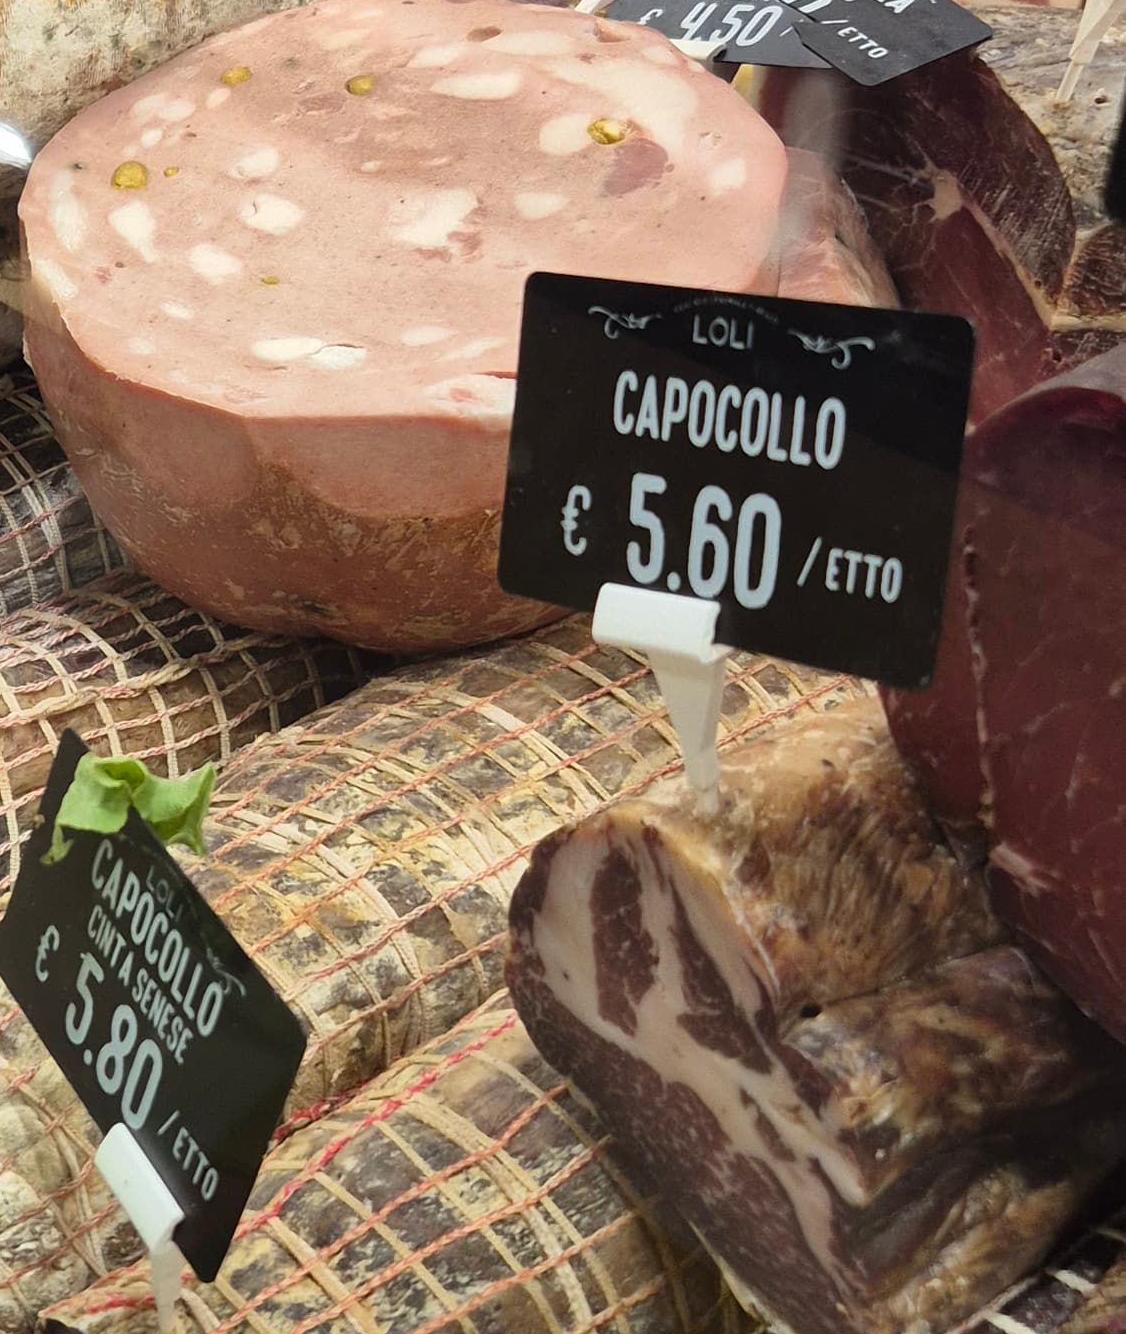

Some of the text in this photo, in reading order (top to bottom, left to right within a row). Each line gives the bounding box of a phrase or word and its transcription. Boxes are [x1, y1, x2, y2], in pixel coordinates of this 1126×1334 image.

[680, 2, 783, 47] 4.50
[692, 314, 754, 350] LOLI
[613, 369, 846, 471] CAPOCOLLO
[561, 484, 592, 557] €
[626, 472, 782, 610] 5.60
[90, 838, 224, 1038] CAPOCOLLO
[147, 863, 182, 925] LOLI
[35, 924, 59, 982] €
[64, 952, 163, 1131] 5.80
[86, 904, 195, 1065] CINTA SENESE
